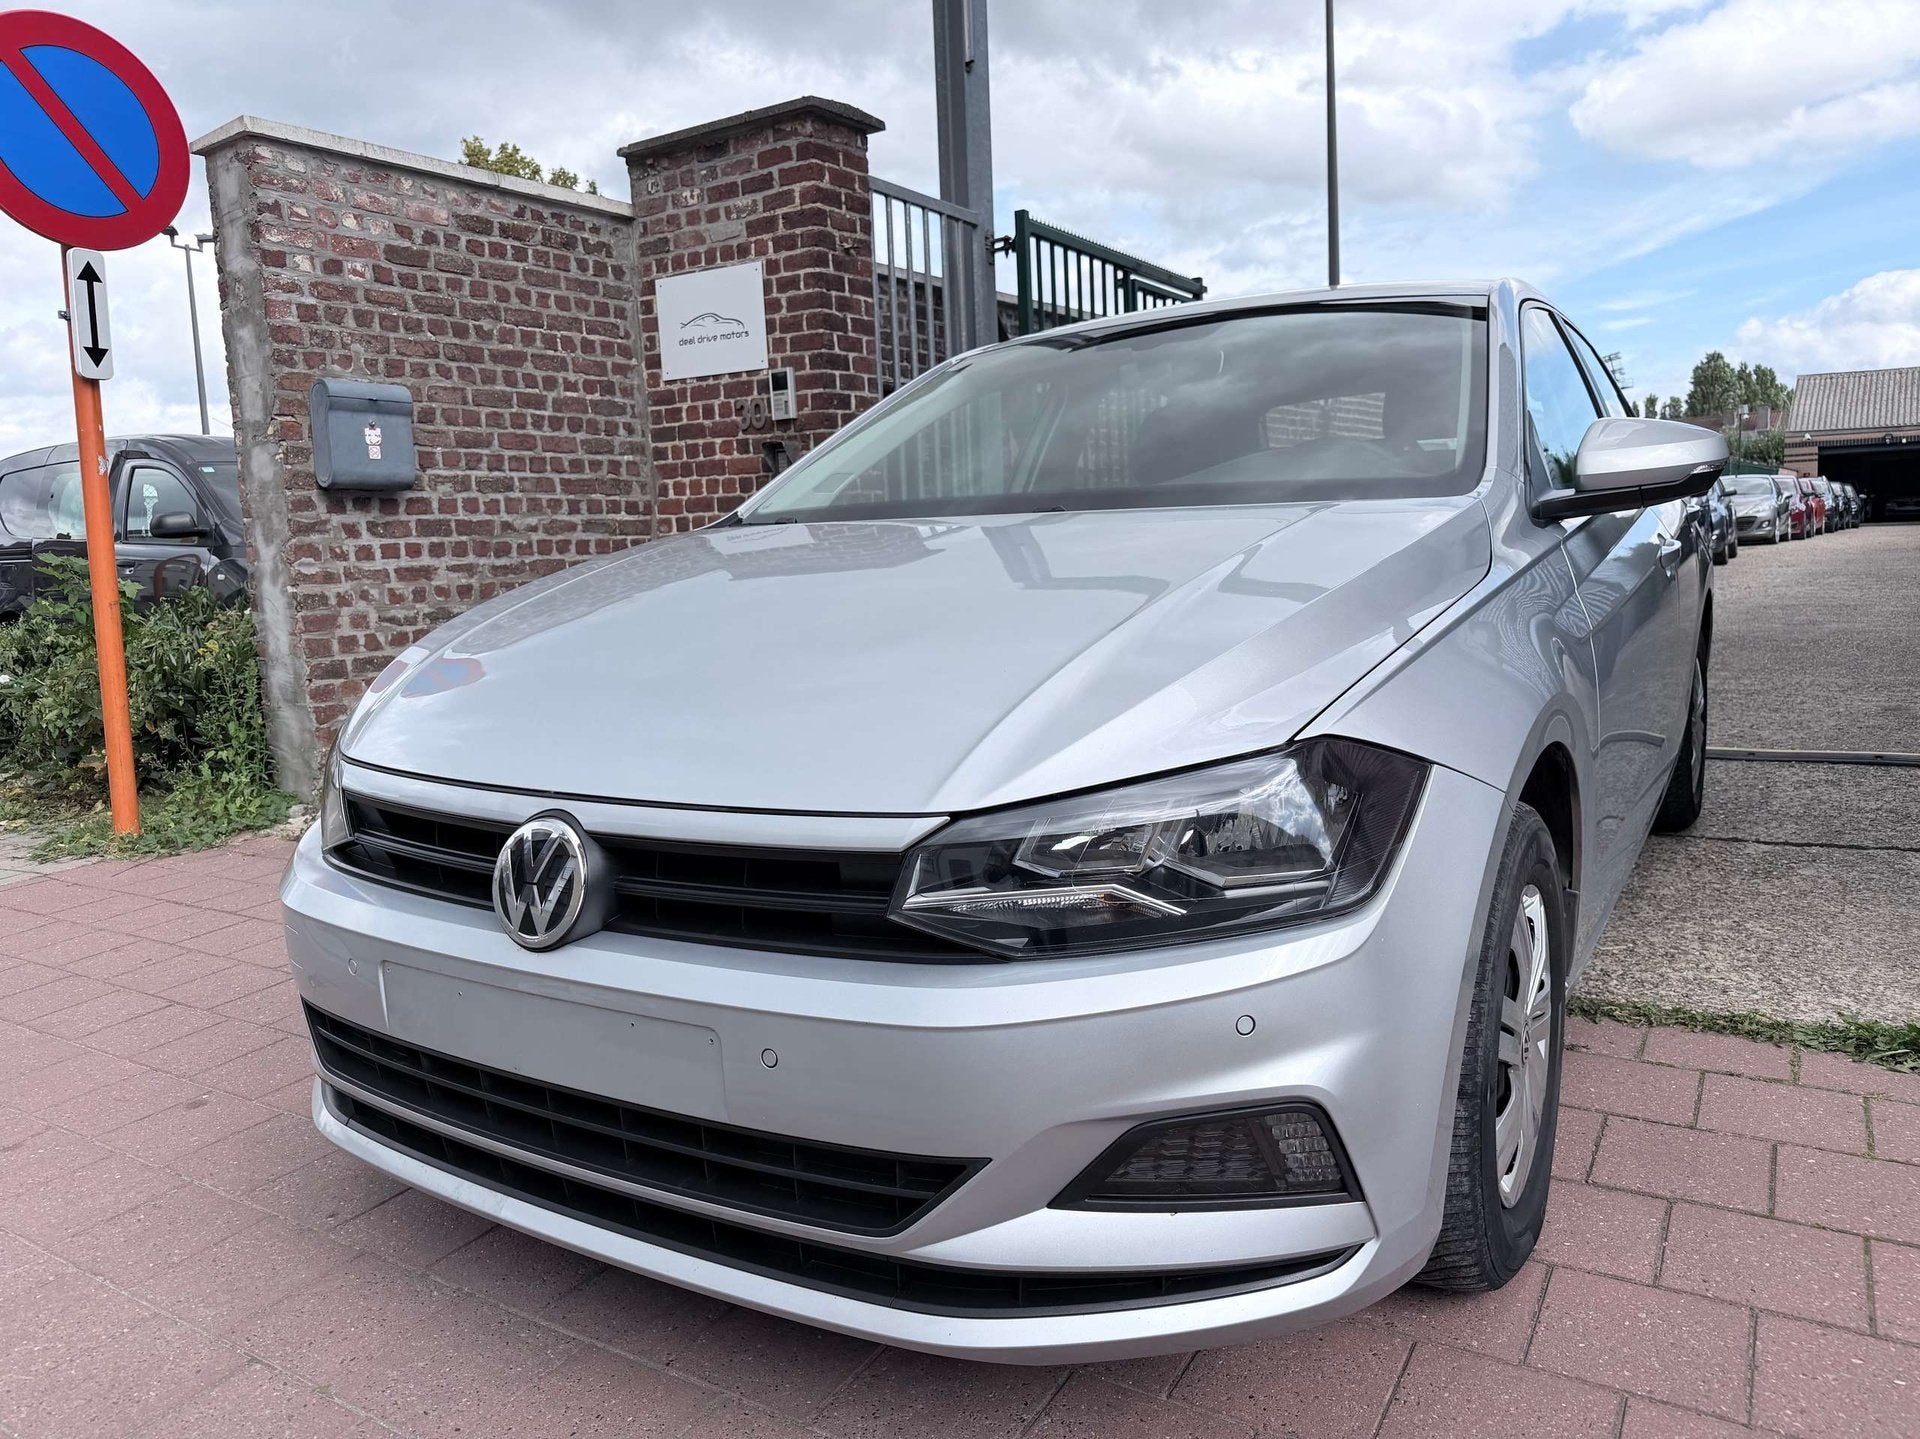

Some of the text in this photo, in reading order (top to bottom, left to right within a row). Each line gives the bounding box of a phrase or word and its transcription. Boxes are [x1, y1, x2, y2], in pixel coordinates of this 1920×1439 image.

[697, 334, 718, 344] drive
[720, 330, 750, 341] motors
[734, 398, 766, 430] 30
[496, 822, 583, 943] VW
